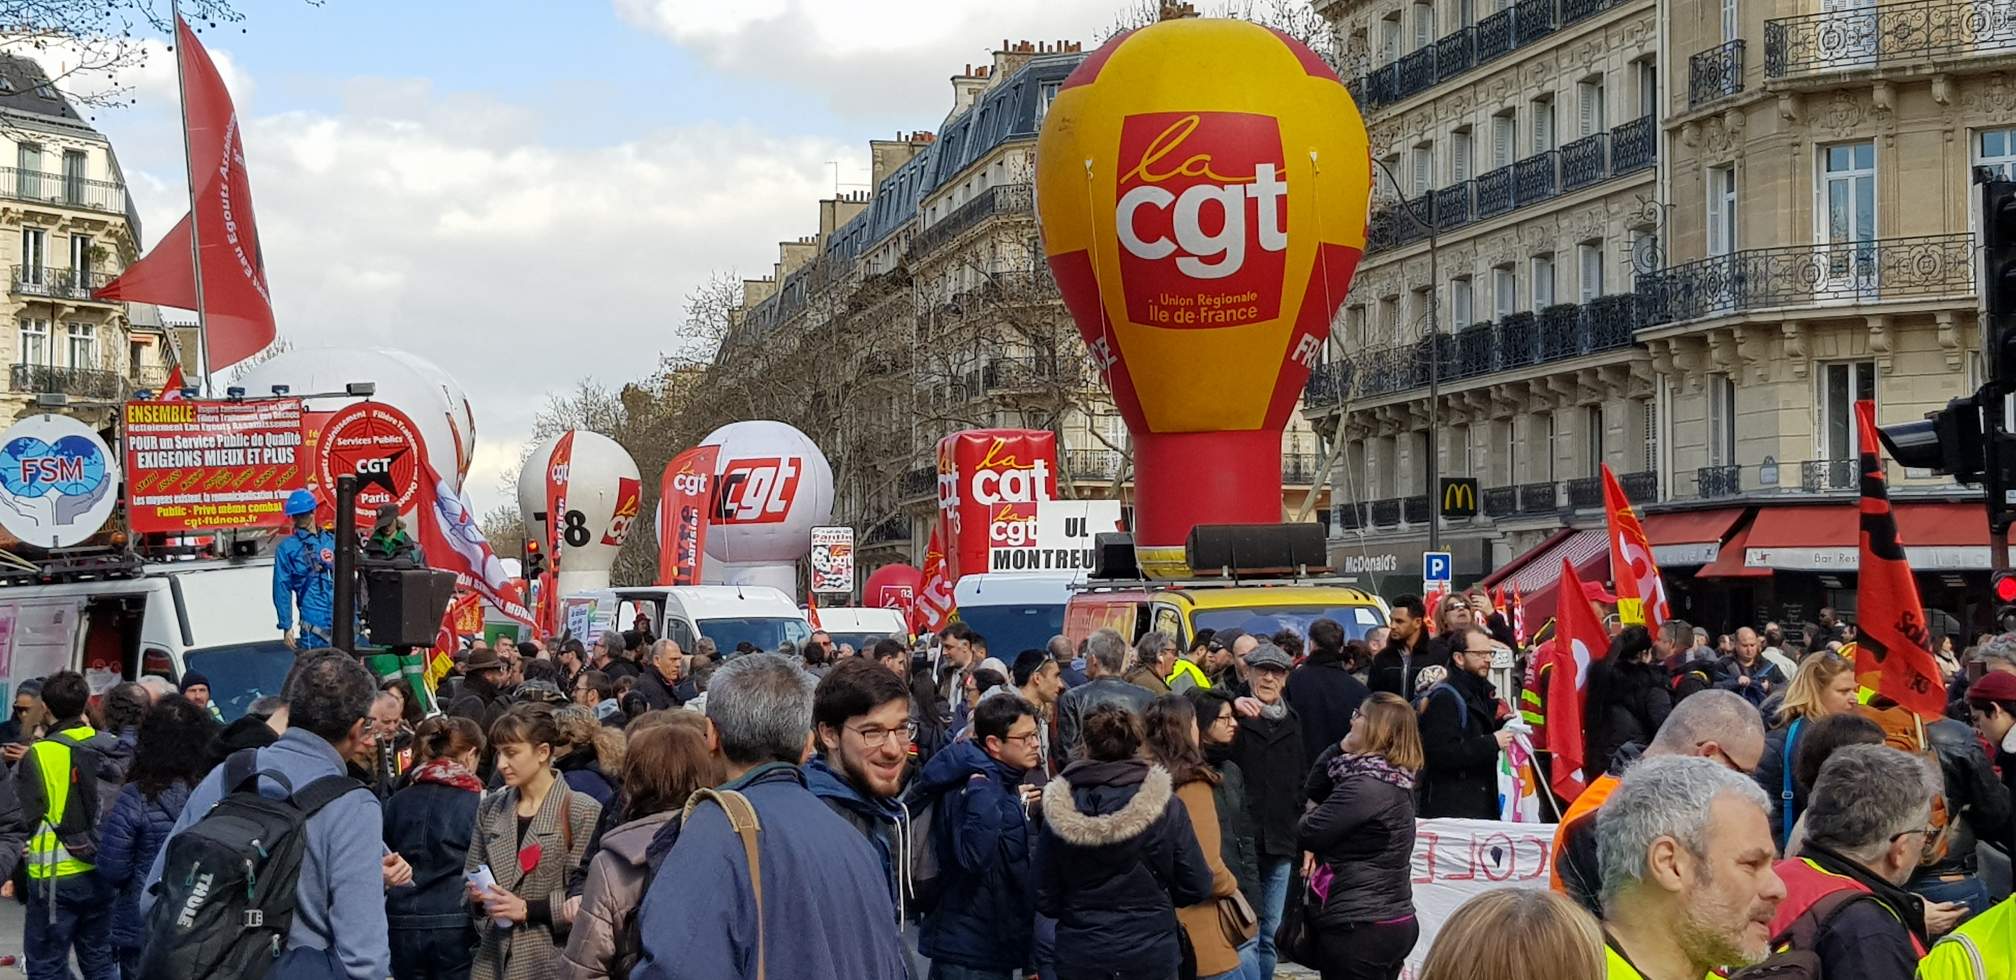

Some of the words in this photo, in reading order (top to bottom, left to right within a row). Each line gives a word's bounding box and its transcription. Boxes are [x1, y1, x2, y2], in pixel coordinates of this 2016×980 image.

[1120, 115, 1257, 184] la
[220, 183, 238, 245] Egouts
[1115, 163, 1288, 279] cgt
[235, 246, 253, 279] Eau
[1160, 293, 1194, 307] Union
[1197, 290, 1258, 308] Régionale
[129, 436, 158, 450] POUR
[159, 437, 174, 449] un
[175, 434, 215, 449] Service
[217, 433, 250, 448] Public
[251, 432, 264, 446] de
[265, 431, 301, 447] Qualité
[337, 437, 372, 446] Services
[373, 435, 403, 445] Publics
[137, 450, 203, 469] EXIGEONS
[204, 448, 246, 467] MIEUX
[248, 447, 262, 464] ET
[263, 446, 295, 464] PLUS
[976, 437, 1034, 470] la
[21, 456, 84, 484] FSM
[356, 457, 391, 474] CGT
[673, 472, 708, 497] cgt
[716, 457, 796, 520] cgt
[972, 459, 1050, 505] cgt
[157, 505, 187, 517] Public
[193, 502, 217, 516] Privé
[218, 502, 247, 514] même
[248, 501, 283, 513] combat
[361, 492, 390, 504] Paris
[993, 503, 1033, 522] la
[687, 508, 699, 567] parisien
[991, 516, 1038, 546] cgt
[1065, 517, 1088, 538] UL
[993, 548, 1095, 570] MONTREU
[1345, 554, 1397, 573] McDonald's
[1431, 558, 1444, 577] P
[1814, 553, 1833, 563] Bar
[1838, 553, 1858, 563] Res
[177, 873, 214, 928] THULE
